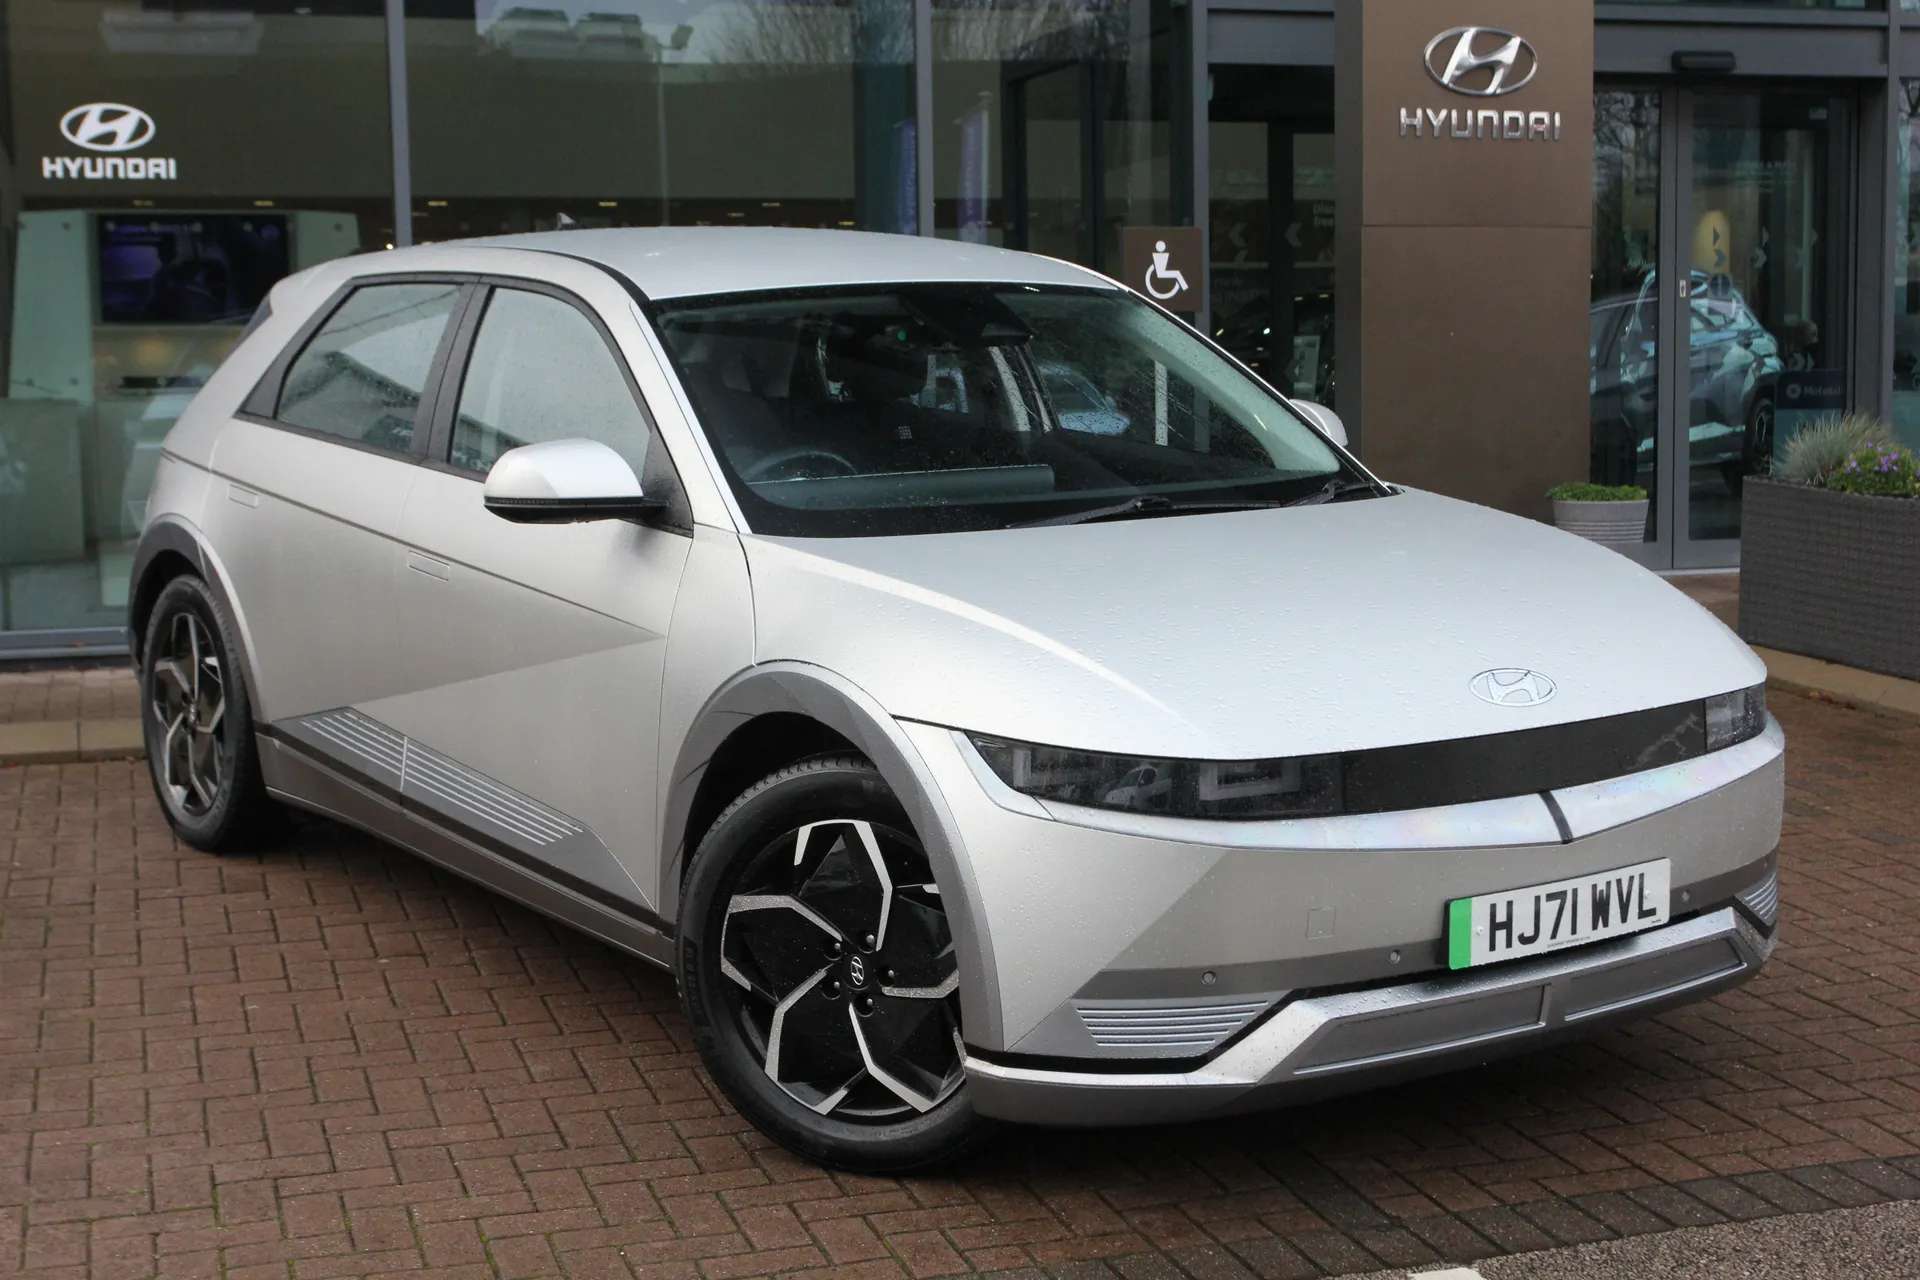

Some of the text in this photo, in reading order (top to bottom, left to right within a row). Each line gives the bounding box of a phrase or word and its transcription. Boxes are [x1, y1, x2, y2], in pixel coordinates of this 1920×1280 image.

[1400, 107, 1561, 140] HYUNDAI
[42, 156, 177, 179] HYUNDAI
[1489, 872, 1656, 951] HJ71 WVL
